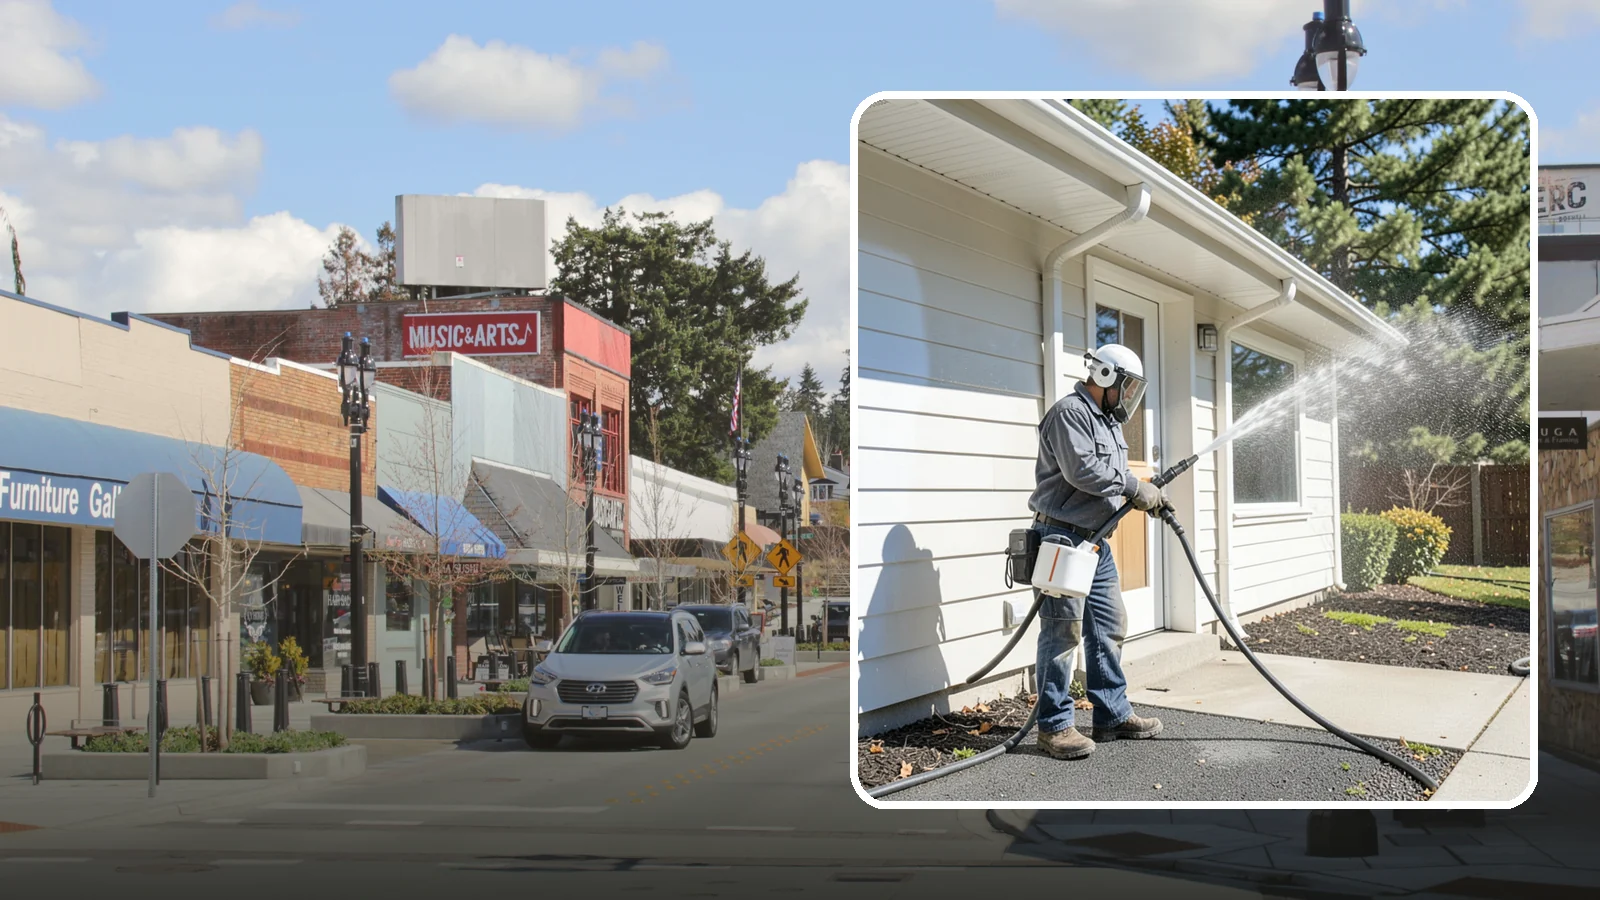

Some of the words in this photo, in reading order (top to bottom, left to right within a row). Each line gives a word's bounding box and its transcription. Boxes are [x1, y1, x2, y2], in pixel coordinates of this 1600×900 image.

[409, 323, 519, 349] MUSIC&ARTS
[0, 472, 79, 515] Furniture
[89, 482, 122, 519] Gal
